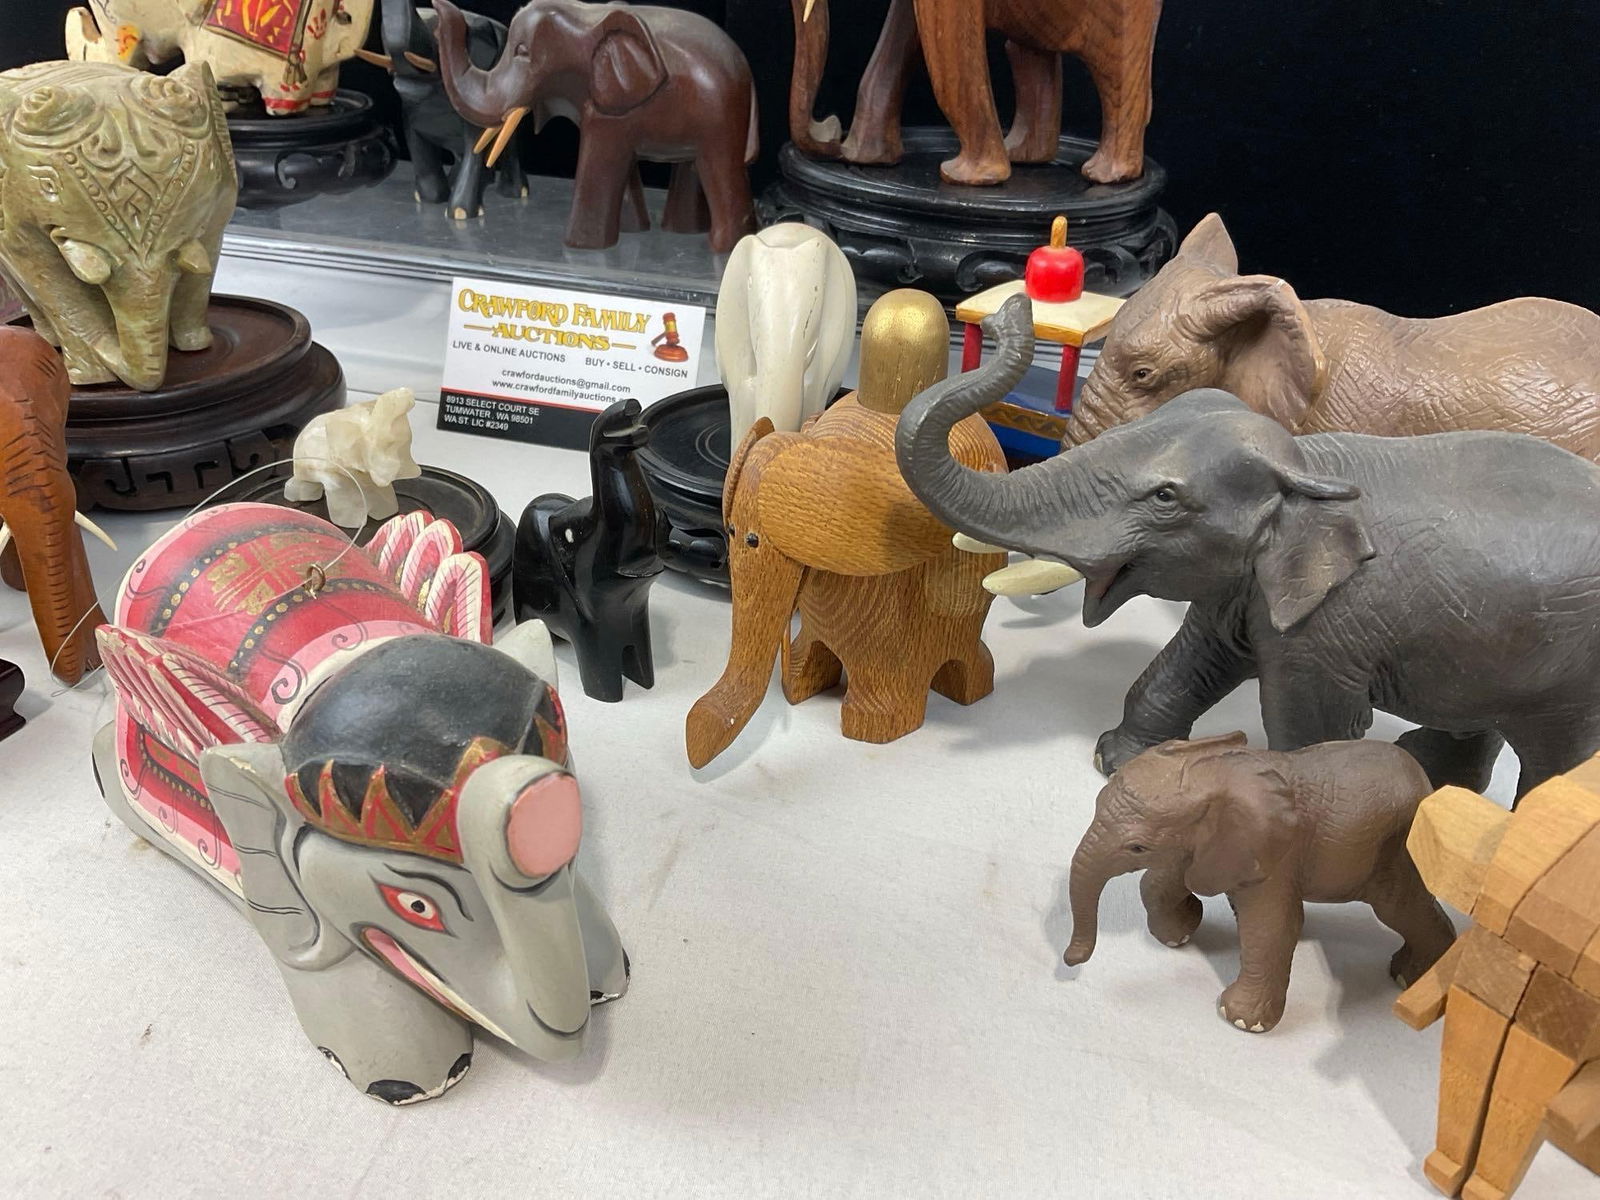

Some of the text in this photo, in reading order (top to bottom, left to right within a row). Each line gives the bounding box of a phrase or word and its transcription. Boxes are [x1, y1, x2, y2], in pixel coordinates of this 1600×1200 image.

[458, 288, 651, 334] CRAWFORD FAMILY
[492, 322, 611, 351] AUCTIONS
[452, 340, 566, 363] LIVE & ONLINE AUCTIONS
[585, 357, 688, 378] BUY SELL CONSIGN
[502, 369, 631, 393] crawfordauctions@gmail.com
[445, 405, 534, 424] TUMWATER WA 98501
[446, 395, 540, 416] 8913 SELECT COURT SE
[444, 414, 457, 423] WA
[471, 418, 484, 428] LIC
[485, 421, 509, 431] #2349
